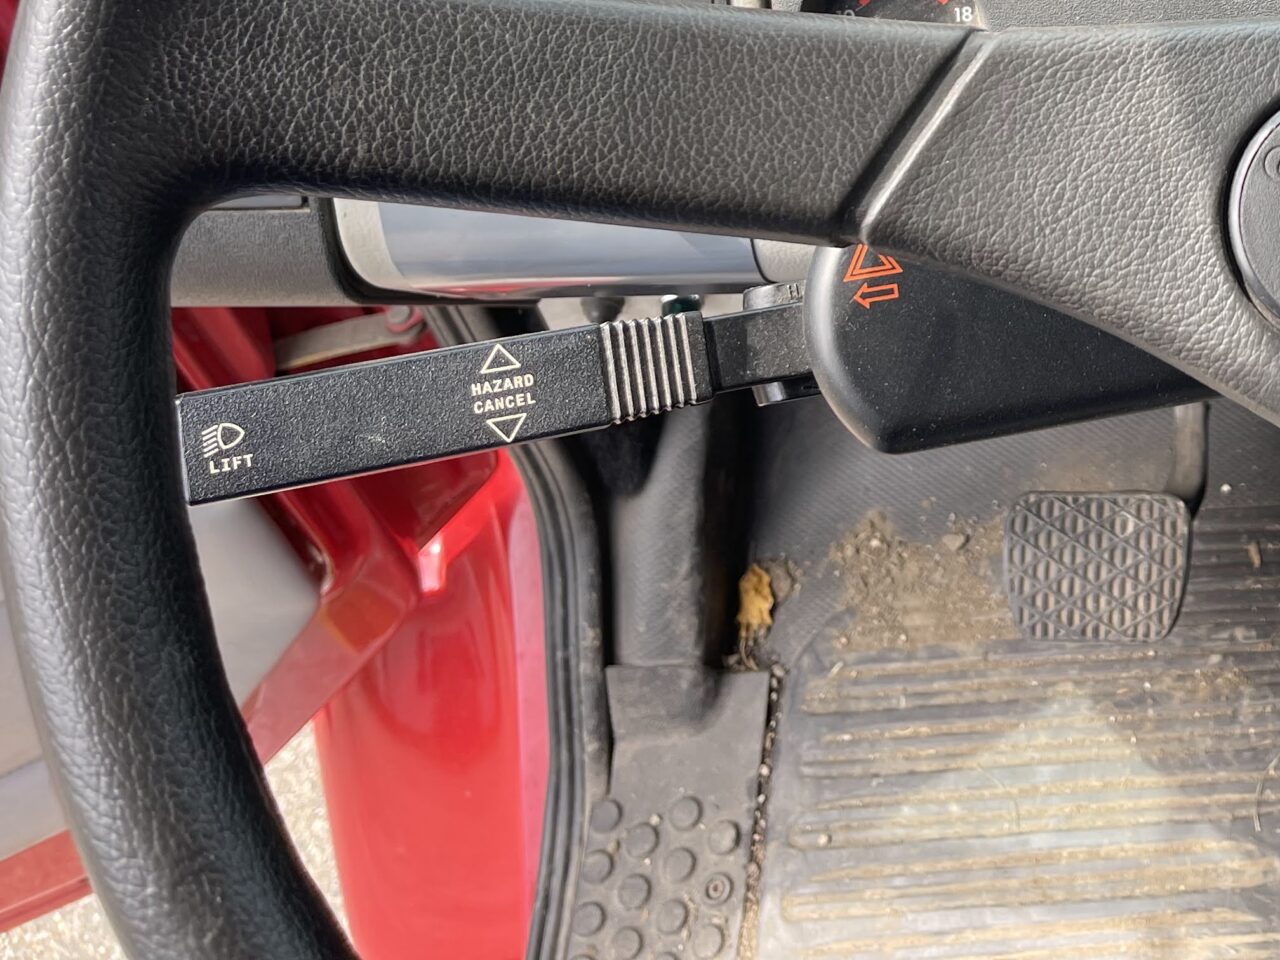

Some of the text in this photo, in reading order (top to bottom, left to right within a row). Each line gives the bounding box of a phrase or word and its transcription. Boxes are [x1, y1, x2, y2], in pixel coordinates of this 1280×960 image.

[954, 6, 973, 22] 18
[471, 374, 535, 396] HAZARD
[473, 391, 536, 414] CANCEL
[209, 453, 254, 474] LIFT
